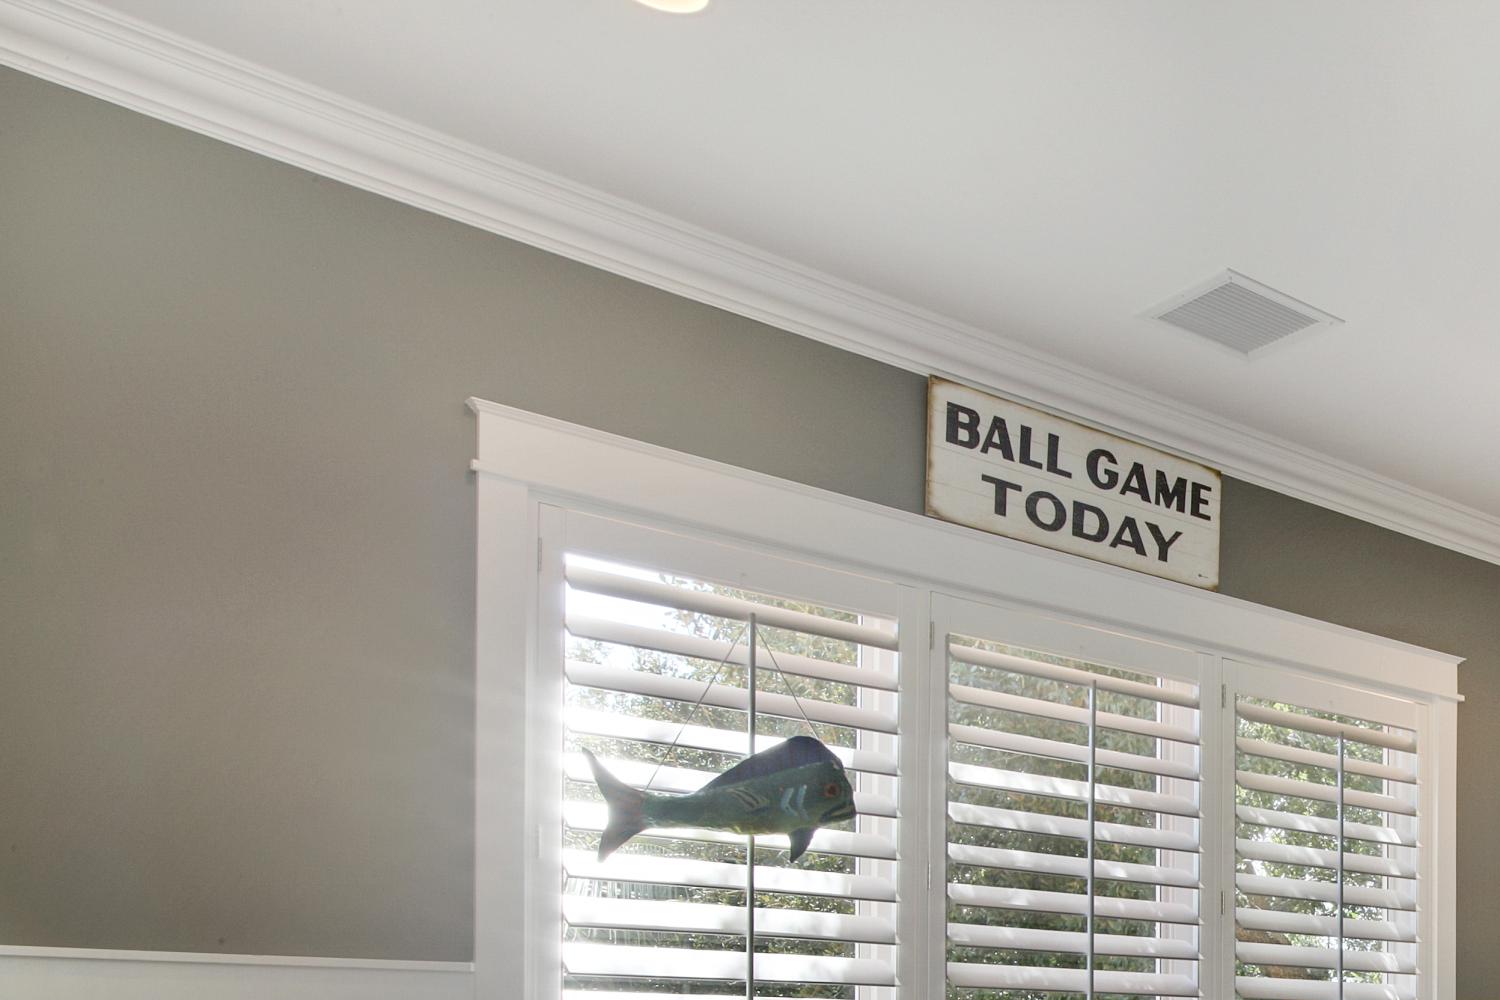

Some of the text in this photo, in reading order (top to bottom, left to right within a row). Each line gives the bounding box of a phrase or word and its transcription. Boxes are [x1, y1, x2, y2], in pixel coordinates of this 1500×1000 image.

[945, 401, 1212, 521] BALL GAME
[981, 473, 1183, 562] TODAY
